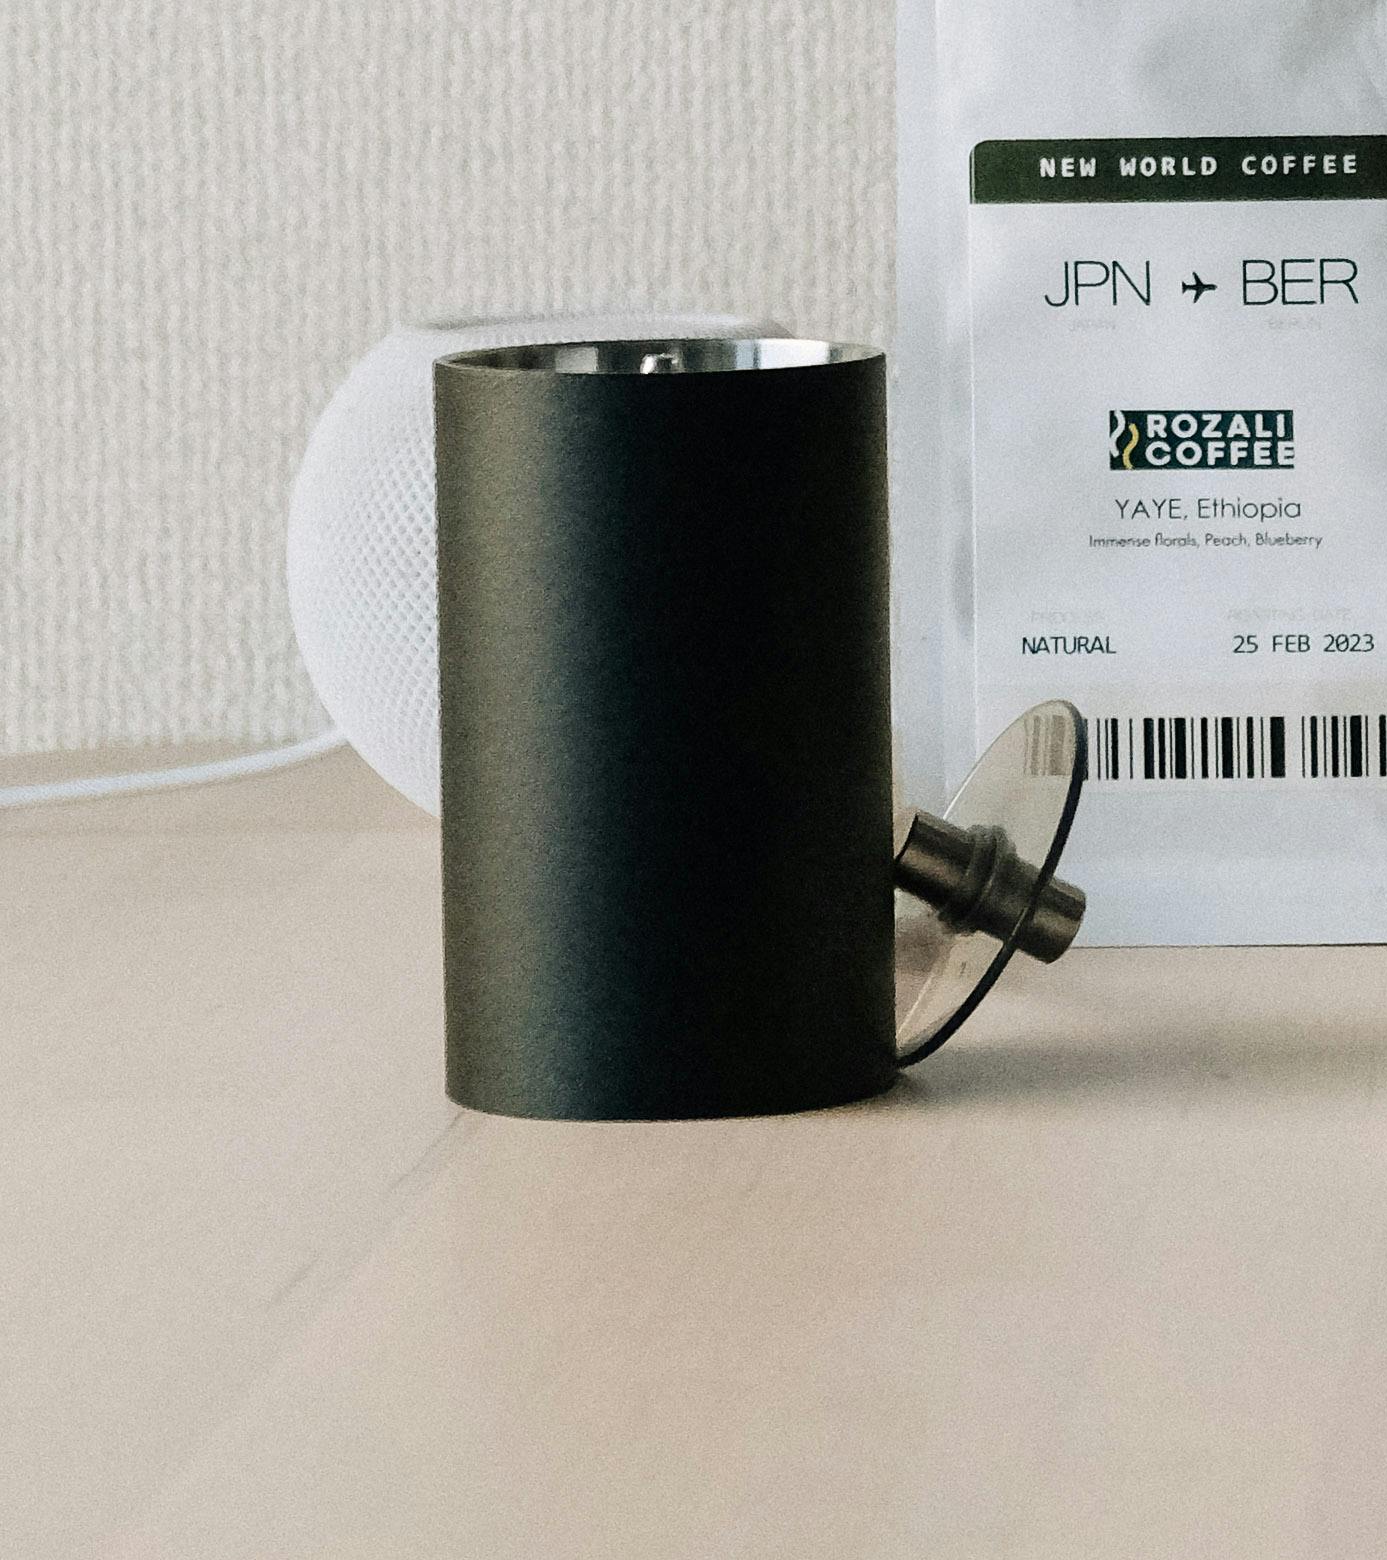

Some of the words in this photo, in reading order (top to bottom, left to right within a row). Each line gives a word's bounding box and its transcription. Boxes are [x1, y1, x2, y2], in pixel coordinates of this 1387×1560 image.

[1039, 157, 1096, 178] NEW
[1119, 156, 1217, 177] WORLD
[1241, 154, 1357, 175] COFFEE
[1044, 260, 1151, 308] JPN
[1242, 257, 1359, 306] BER
[1146, 413, 1286, 439] ROZALI
[1145, 440, 1295, 466] COFFEE
[1114, 498, 1188, 520] YAYE,
[1197, 497, 1302, 523] Ethiopia
[1089, 534, 1151, 548] Immense
[1154, 531, 1200, 548] florals,
[1204, 532, 1251, 547] Peach,
[1255, 531, 1323, 549] Blueberry
[1021, 635, 1117, 655] NATURAL
[1232, 634, 1259, 654] 25
[1272, 634, 1311, 653] FEB
[1323, 633, 1375, 653] 2023
